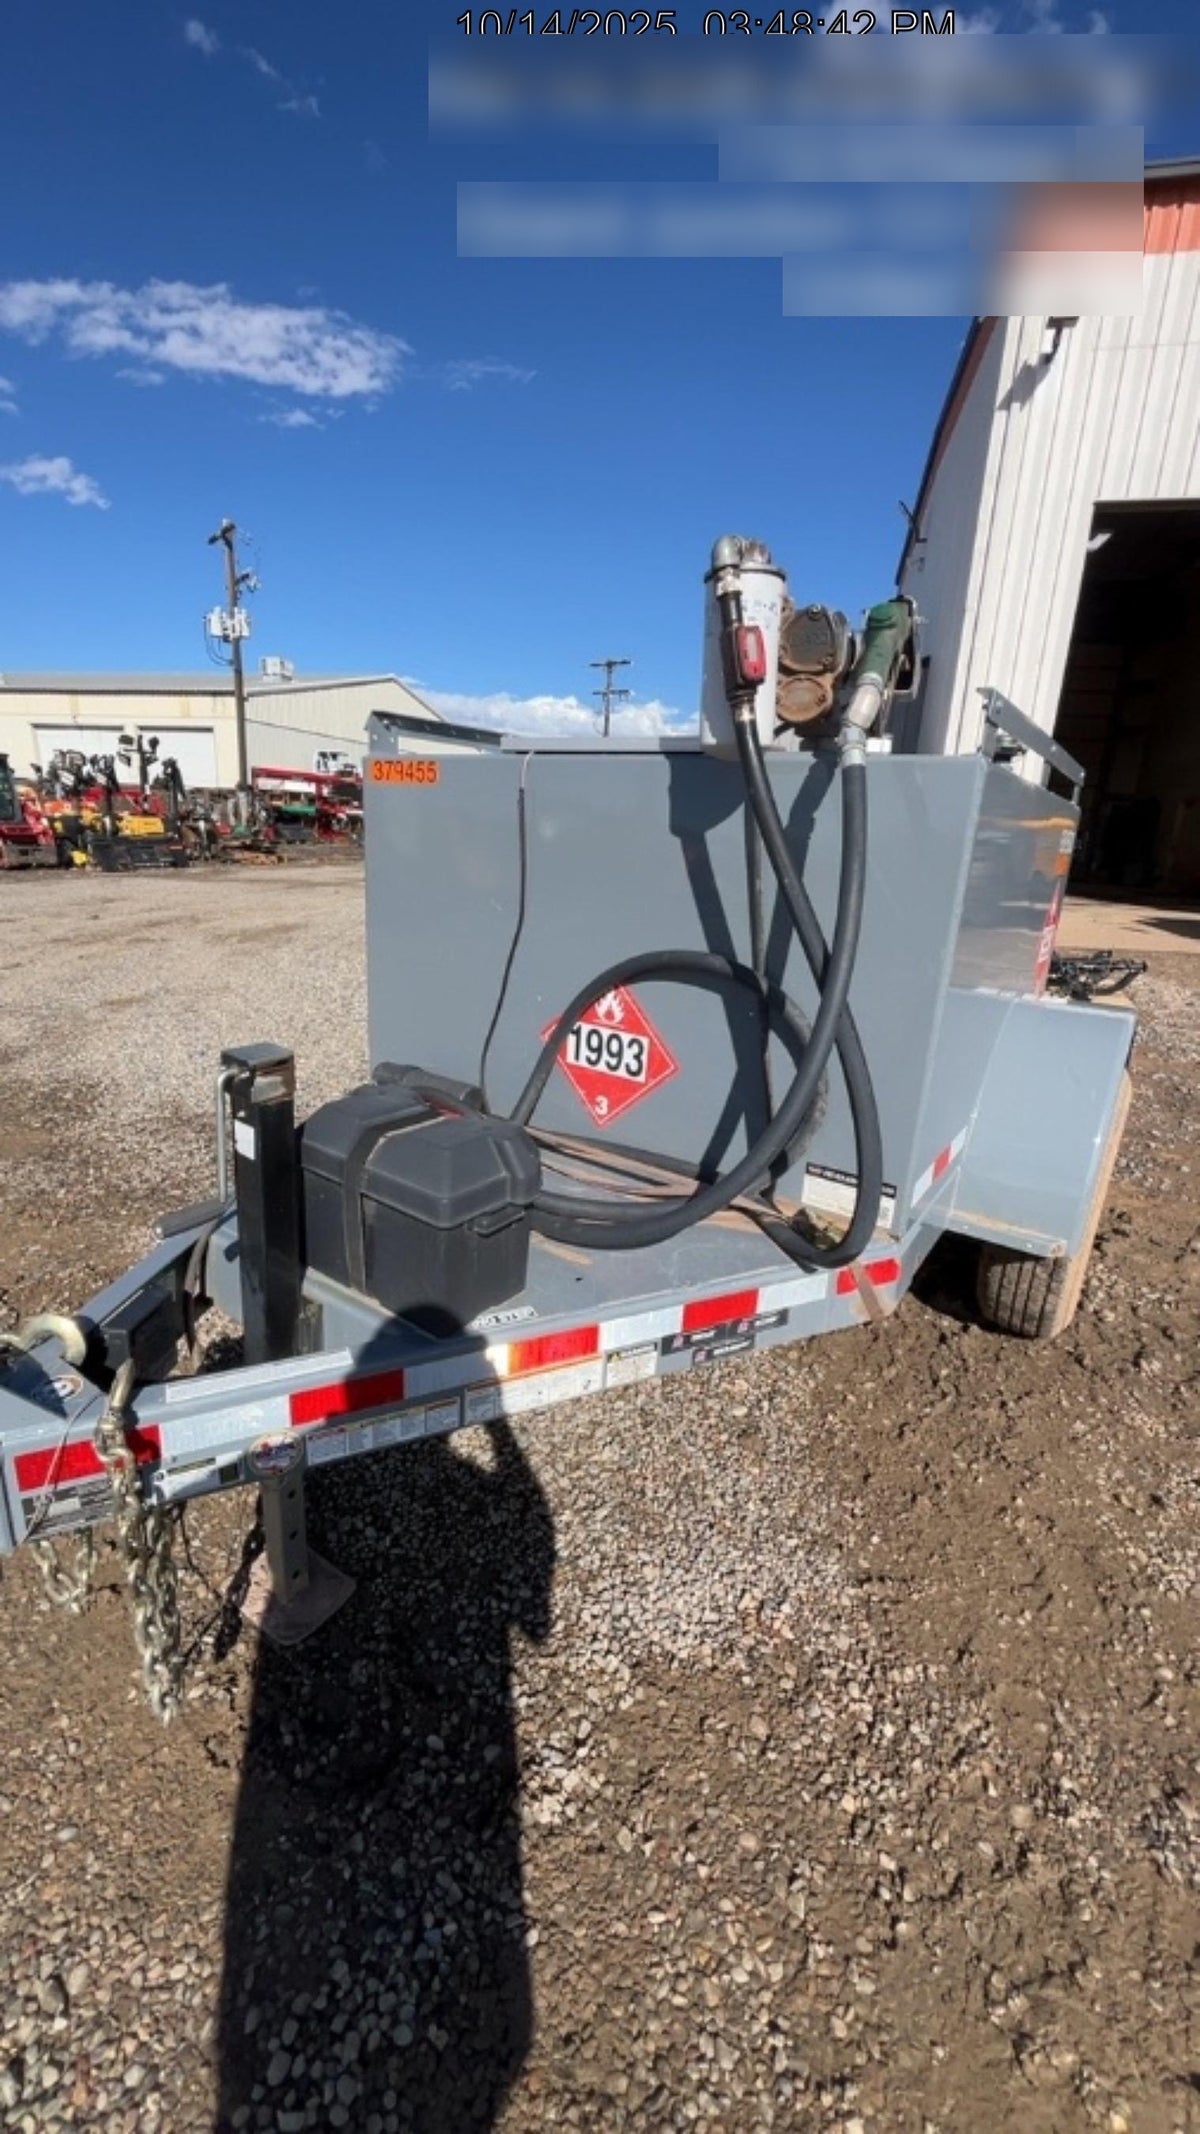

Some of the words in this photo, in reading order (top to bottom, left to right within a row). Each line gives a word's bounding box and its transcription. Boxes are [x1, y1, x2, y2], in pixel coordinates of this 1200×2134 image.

[374, 761, 437, 783] 379455
[571, 1024, 645, 1077] 1993
[595, 1095, 609, 1115] 3
